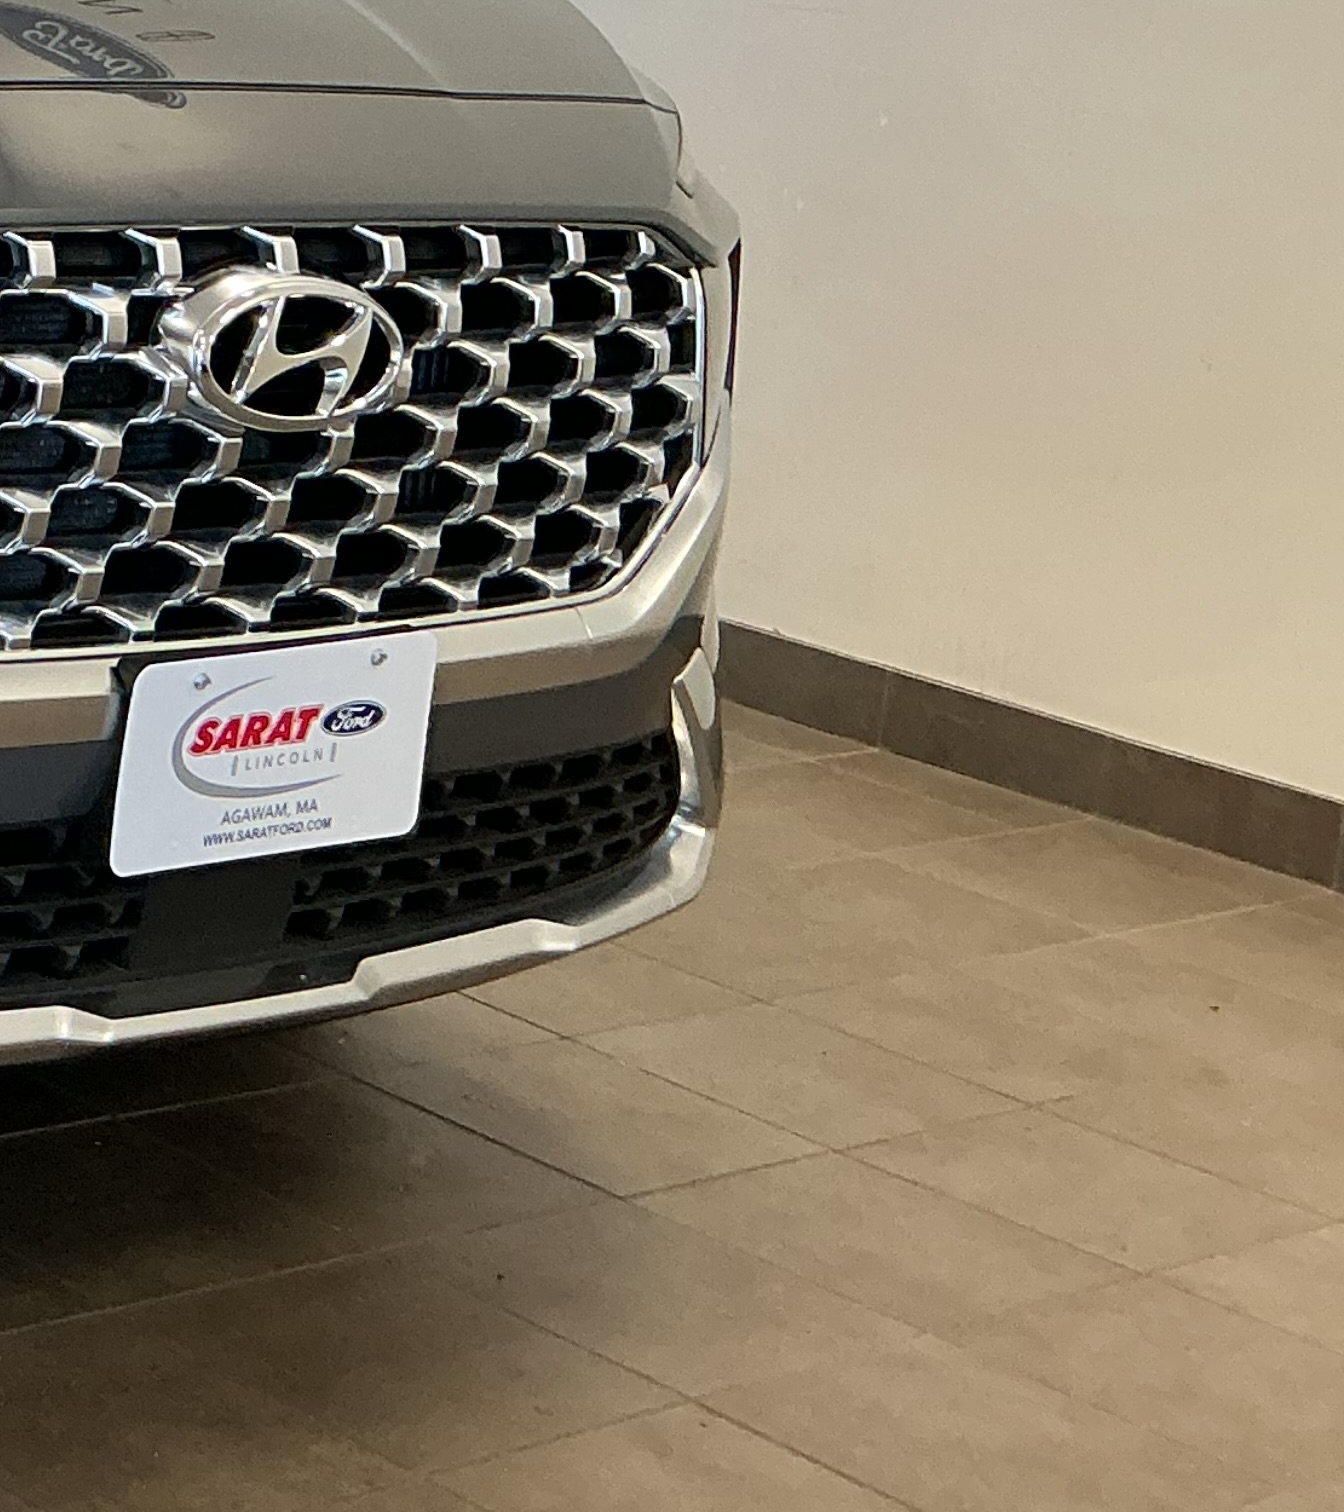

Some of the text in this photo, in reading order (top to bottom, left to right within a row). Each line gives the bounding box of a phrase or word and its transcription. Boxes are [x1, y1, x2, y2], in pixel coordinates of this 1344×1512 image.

[188, 704, 324, 756] SARAT
[245, 748, 323, 771] LINCOLN
[220, 798, 318, 826] AGAWAM, MA
